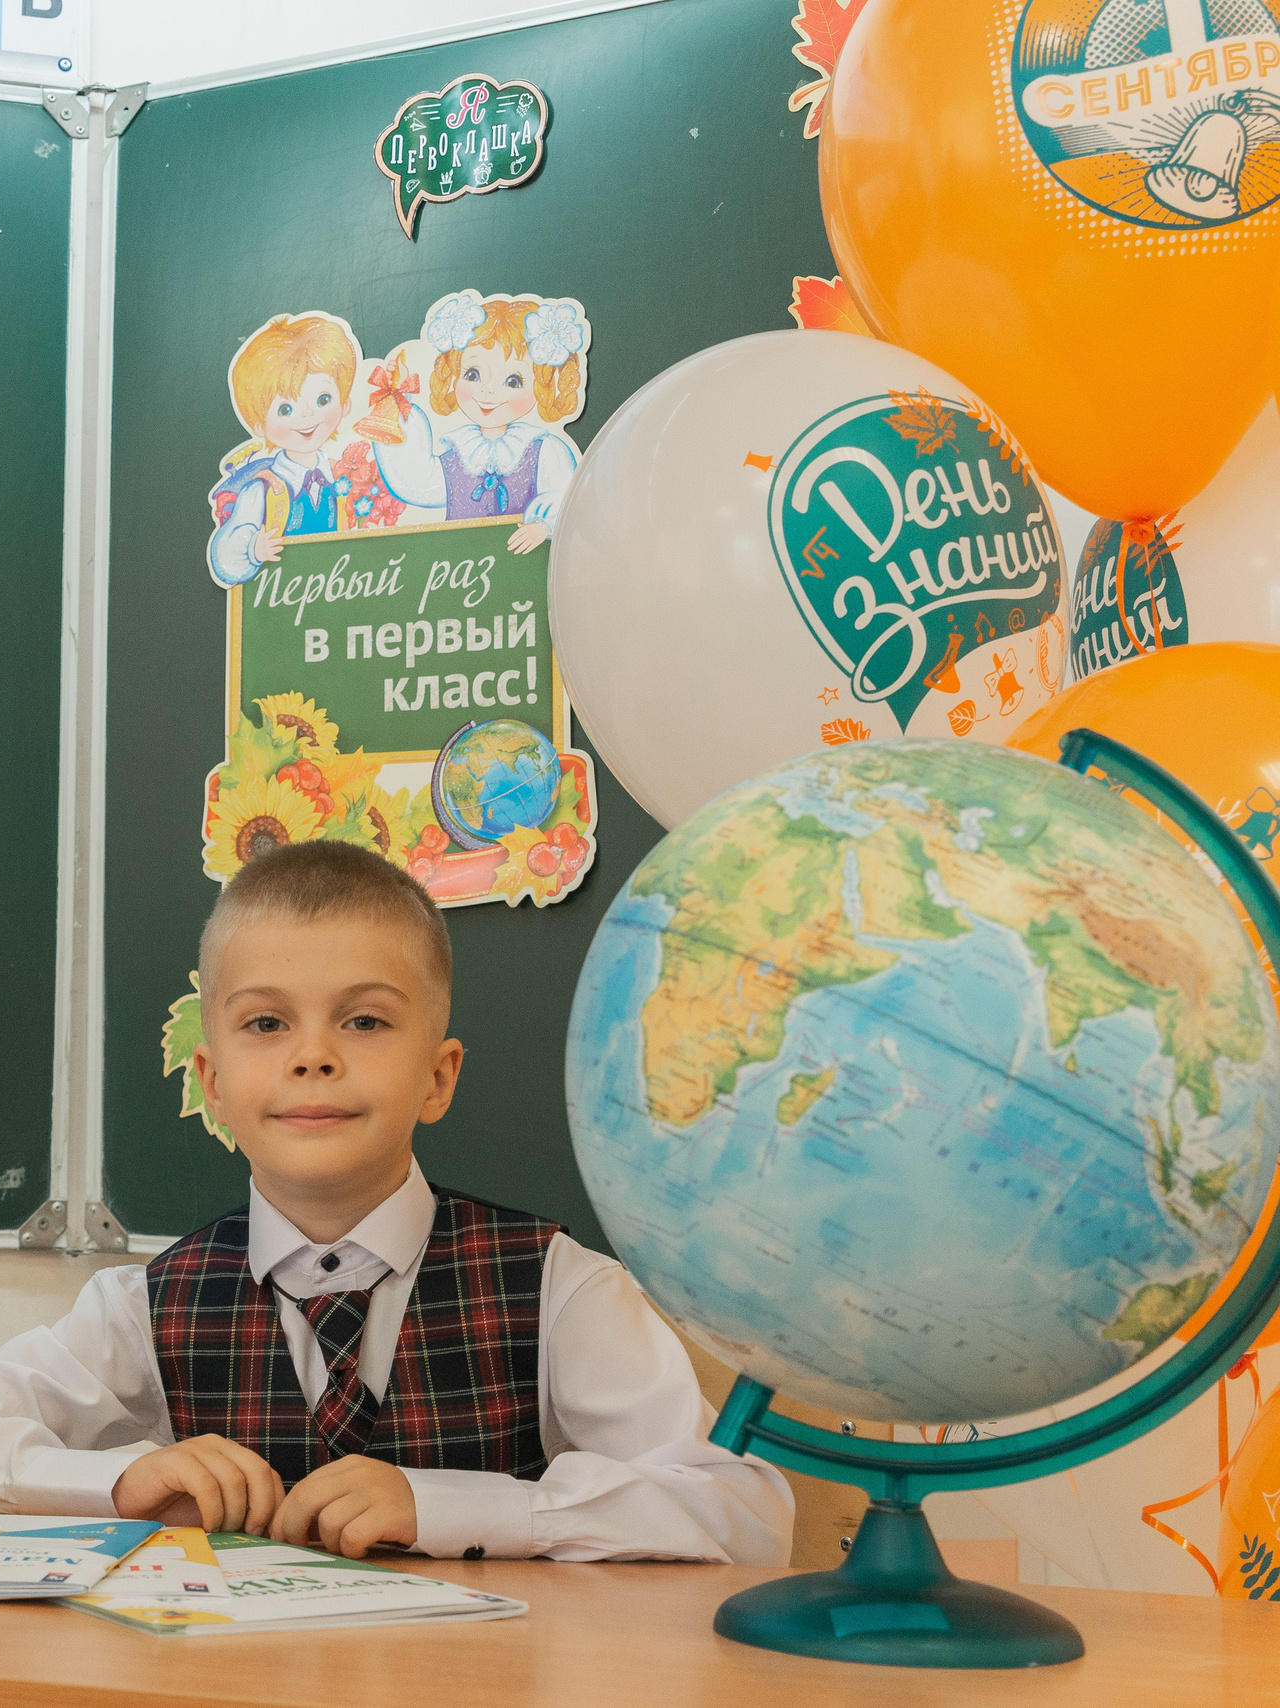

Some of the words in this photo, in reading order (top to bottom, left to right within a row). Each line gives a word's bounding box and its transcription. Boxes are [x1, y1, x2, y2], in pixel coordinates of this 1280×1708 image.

[446, 82, 490, 129] Я
[390, 119, 532, 174] ПЕРВОКЛАШКА
[791, 446, 1012, 563] День
[253, 553, 407, 626] Первый
[417, 555, 496, 614] раз
[832, 504, 1058, 703] Знаний
[304, 628, 330, 663] в
[346, 600, 537, 668] первый
[383, 656, 538, 713] класс!
